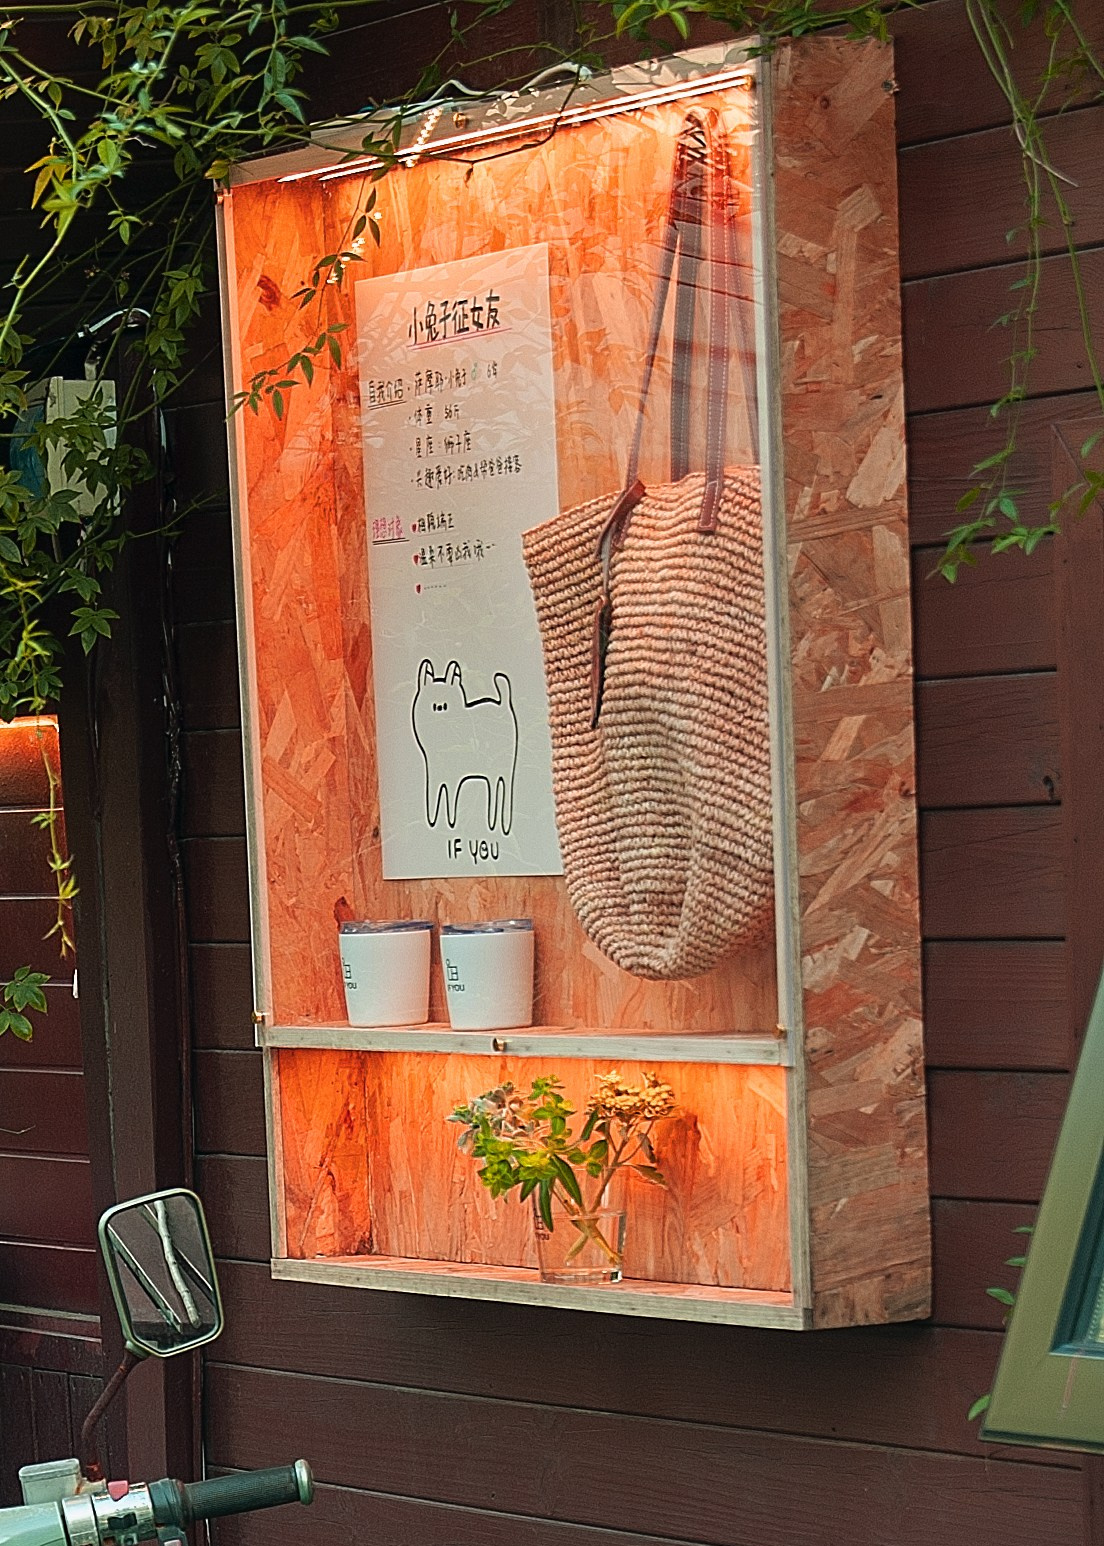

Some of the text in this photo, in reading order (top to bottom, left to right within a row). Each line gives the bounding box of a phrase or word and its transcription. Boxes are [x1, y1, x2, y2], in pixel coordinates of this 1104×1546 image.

[408, 288, 500, 345] 小兔子征女友
[368, 378, 404, 403] 自我介绍
[448, 839, 499, 865] IF YOU
